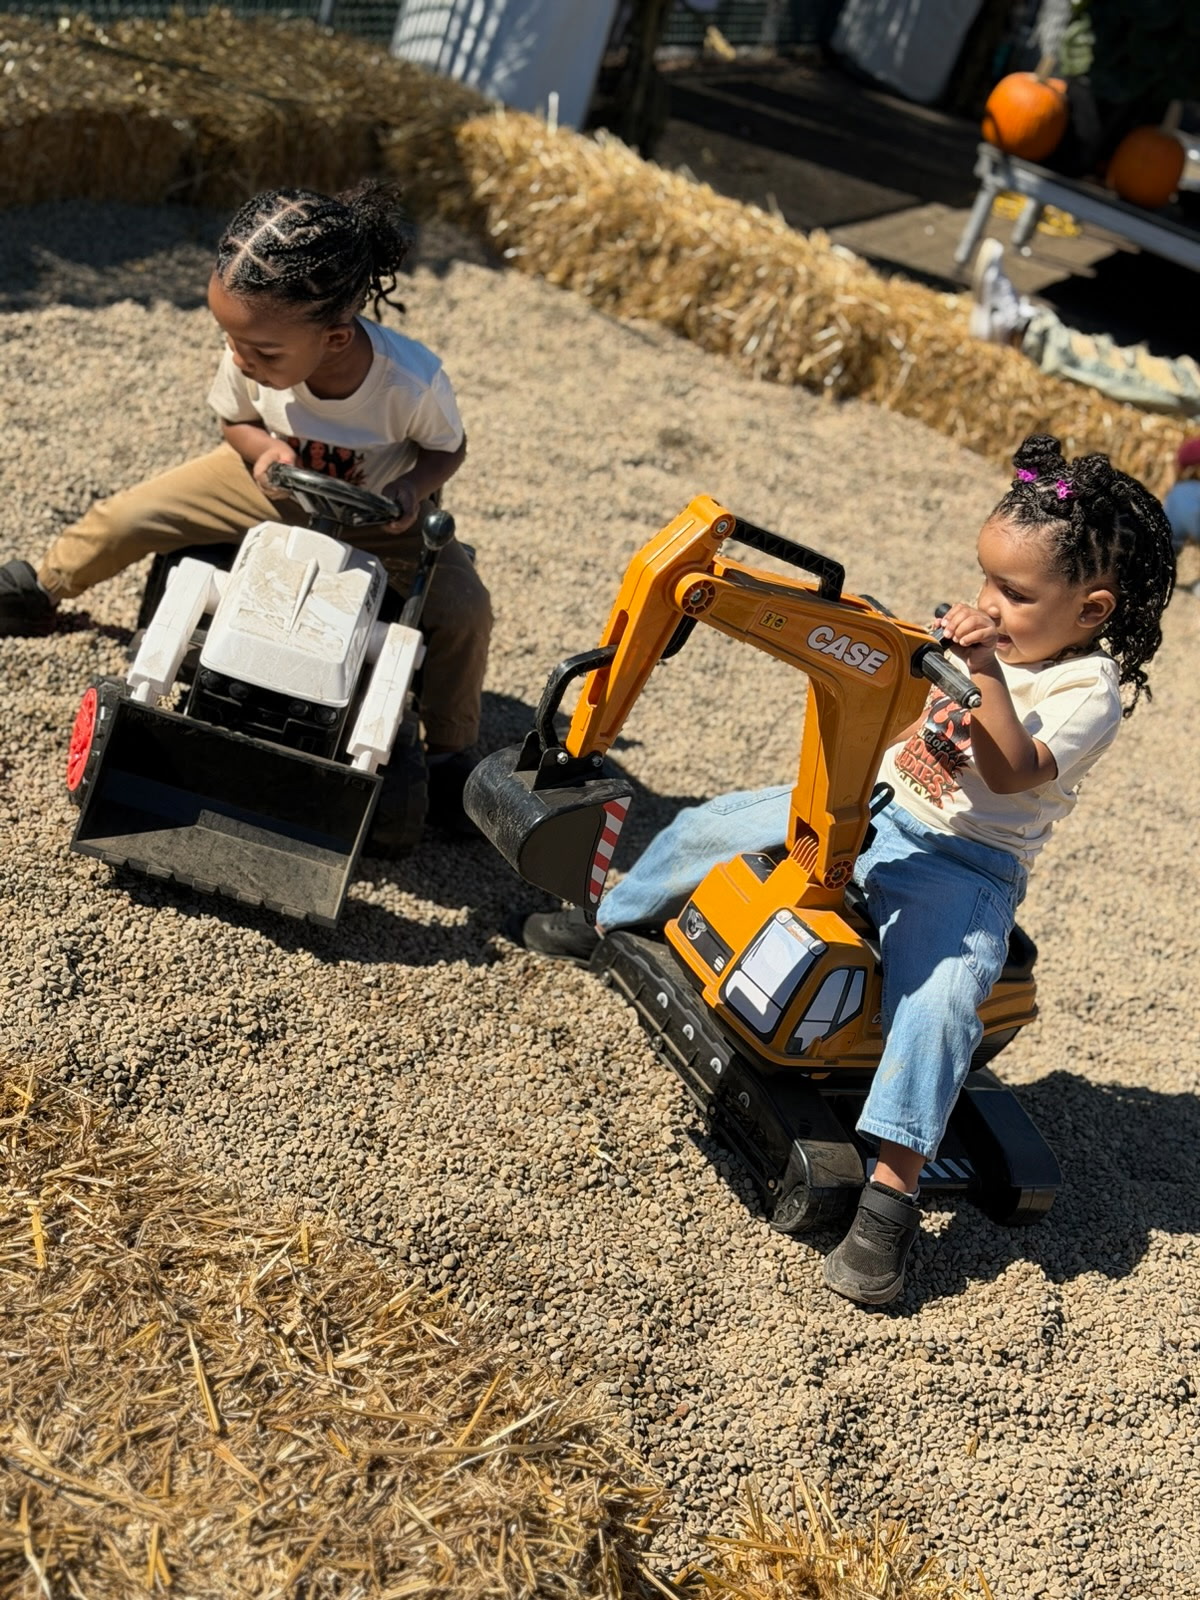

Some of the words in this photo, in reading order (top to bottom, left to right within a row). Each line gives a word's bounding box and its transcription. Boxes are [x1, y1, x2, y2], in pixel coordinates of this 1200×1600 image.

[807, 625, 891, 675] CASE
[917, 727, 936, 743] ild
[932, 738, 948, 751] of
[904, 735, 956, 786] OWN
[897, 769, 932, 800] ACY
